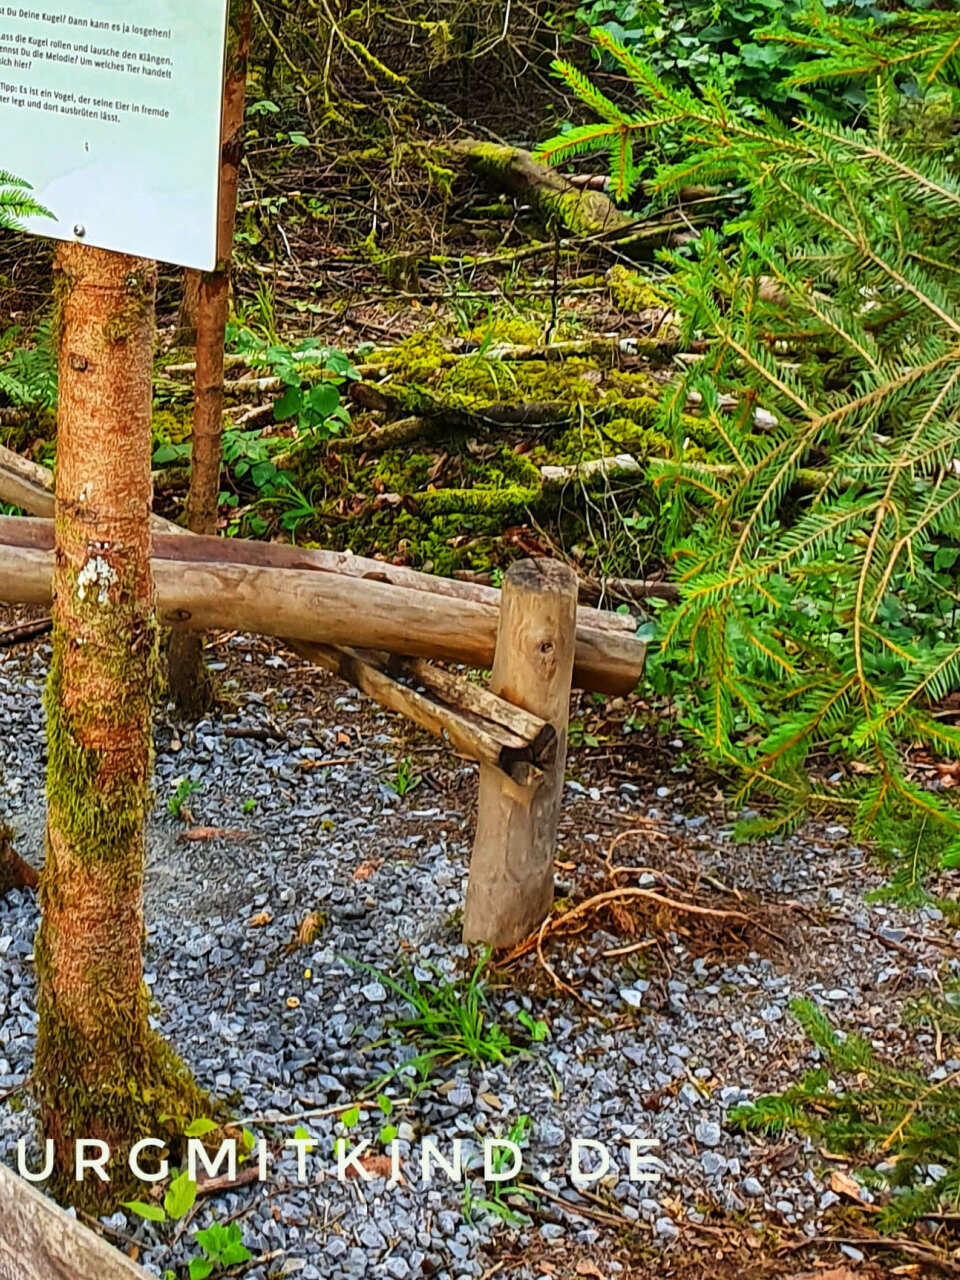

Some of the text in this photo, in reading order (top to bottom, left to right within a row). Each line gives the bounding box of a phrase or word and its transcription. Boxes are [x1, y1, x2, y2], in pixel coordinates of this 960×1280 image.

[7, 7, 17, 17] Du
[19, 8, 40, 20] Deine
[42, 12, 66, 24] Kugel?
[68, 16, 88, 27] Dann
[90, 17, 109, 30] kann
[111, 23, 120, 31] es
[122, 22, 130, 34] ja
[132, 23, 171, 39] losgehen!
[15, 33, 26, 43] die
[28, 36, 48, 48] Kugel
[50, 40, 71, 51] rollen
[73, 43, 88, 53] und
[90, 44, 120, 58] lausche
[122, 49, 137, 61] den
[14, 58, 32, 70] hier?
[21, 47, 31, 57] Du
[32, 49, 43, 59] die
[45, 51, 78, 65] Melodie?
[80, 56, 93, 66] Um
[94, 59, 125, 72] welches
[126, 63, 141, 74] Tier
[142, 64, 172, 79] handelt
[0, 81, 17, 93] Tipp:
[19, 85, 28, 94] Es
[29, 87, 39, 96] ist
[40, 89, 52, 98] ein
[53, 90, 76, 103] Vogel,
[78, 95, 91, 105] der
[92, 98, 113, 109] seine
[115, 101, 130, 111] Eier
[131, 103, 140, 113] in
[141, 104, 170, 118] fremde
[12, 96, 25, 108] legt
[27, 100, 41, 110] und
[43, 102, 58, 112] dort
[60, 106, 98, 119] ausbrüten
[100, 110, 121, 123] lässt.
